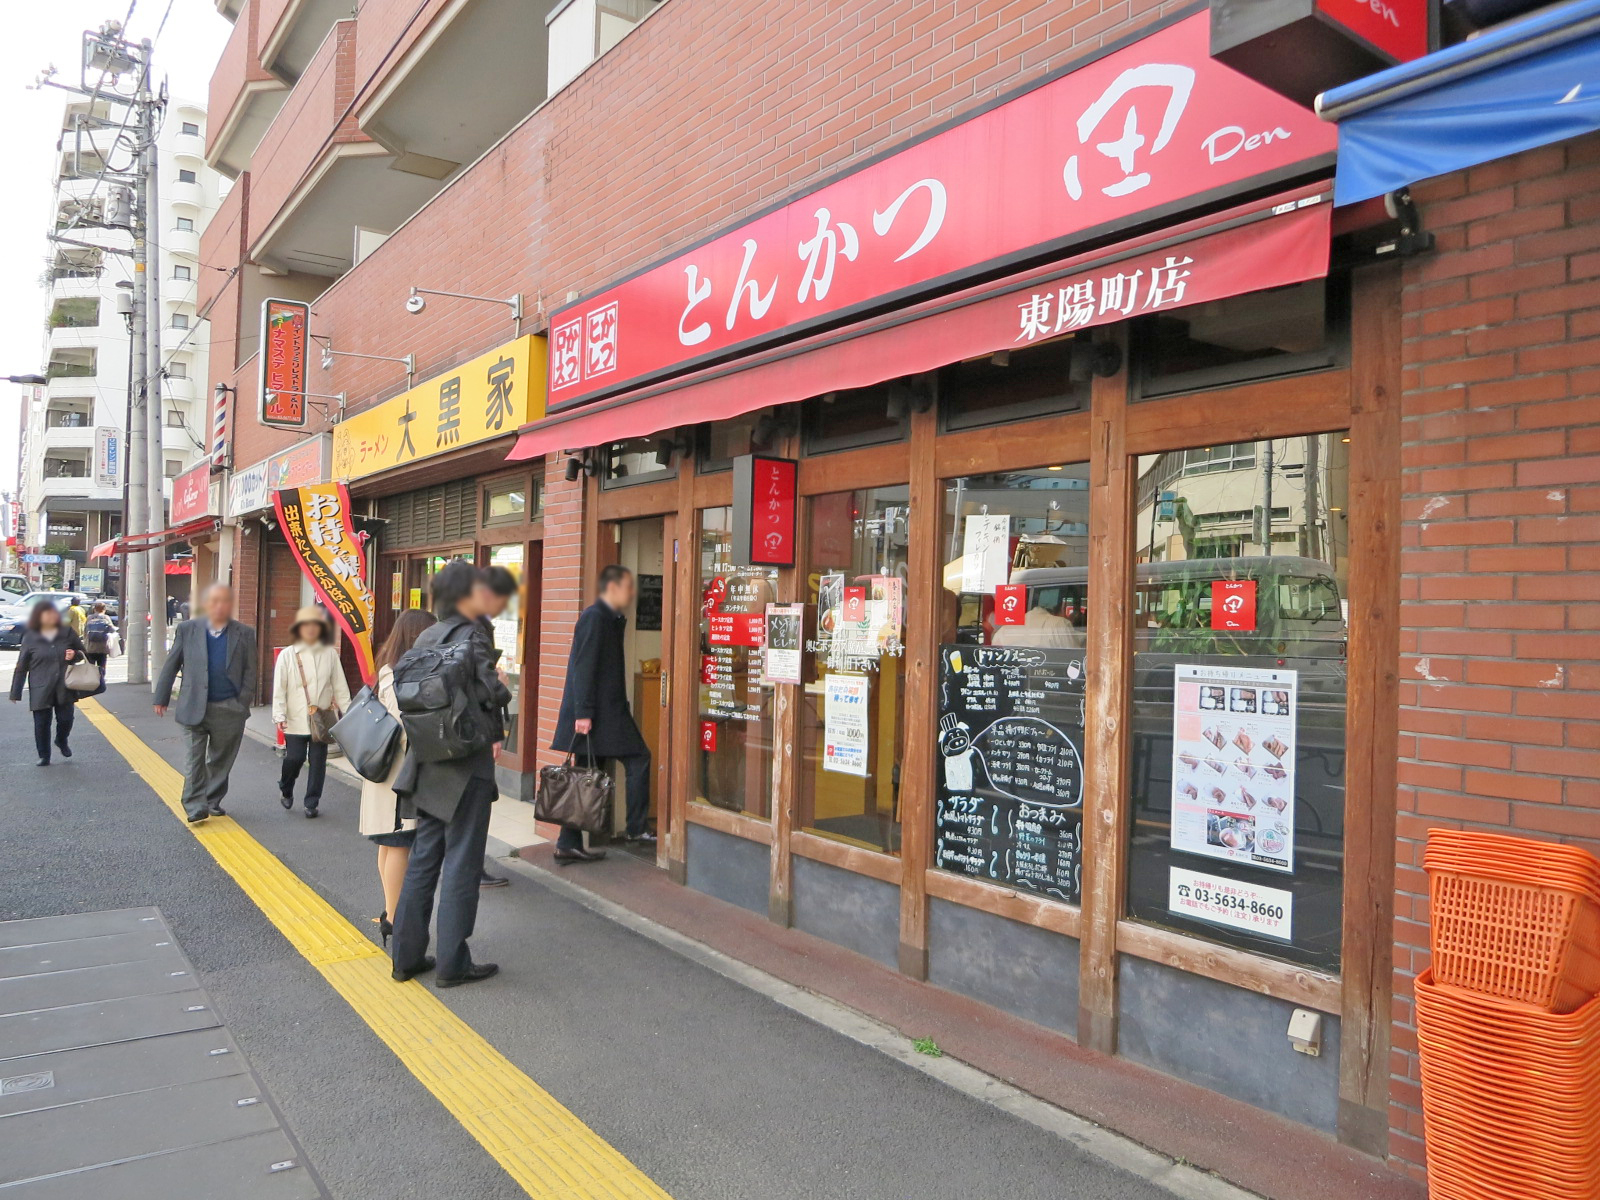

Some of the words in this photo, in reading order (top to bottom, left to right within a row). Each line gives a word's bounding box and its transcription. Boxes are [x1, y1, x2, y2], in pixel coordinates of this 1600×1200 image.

[1201, 126, 1291, 165] Den
[678, 178, 947, 346] とんかつ
[1015, 256, 1193, 342] 東陽町店
[396, 355, 514, 463] 大黒家
[360, 435, 389, 463] ラーメン
[768, 466, 781, 524] とんかつ
[730, 584, 758, 595] 年中無休
[725, 604, 748, 612] ランチタイム
[978, 649, 1041, 664] ドリンクメニュー
[1200, 669, 1269, 680] お持ち帰りメニュー
[948, 796, 984, 813] サラダ
[1019, 802, 1066, 825] おつまみ
[1193, 880, 1263, 900] お持帰りも是非どうぞ…
[1195, 888, 1284, 920] 03-5634-8660
